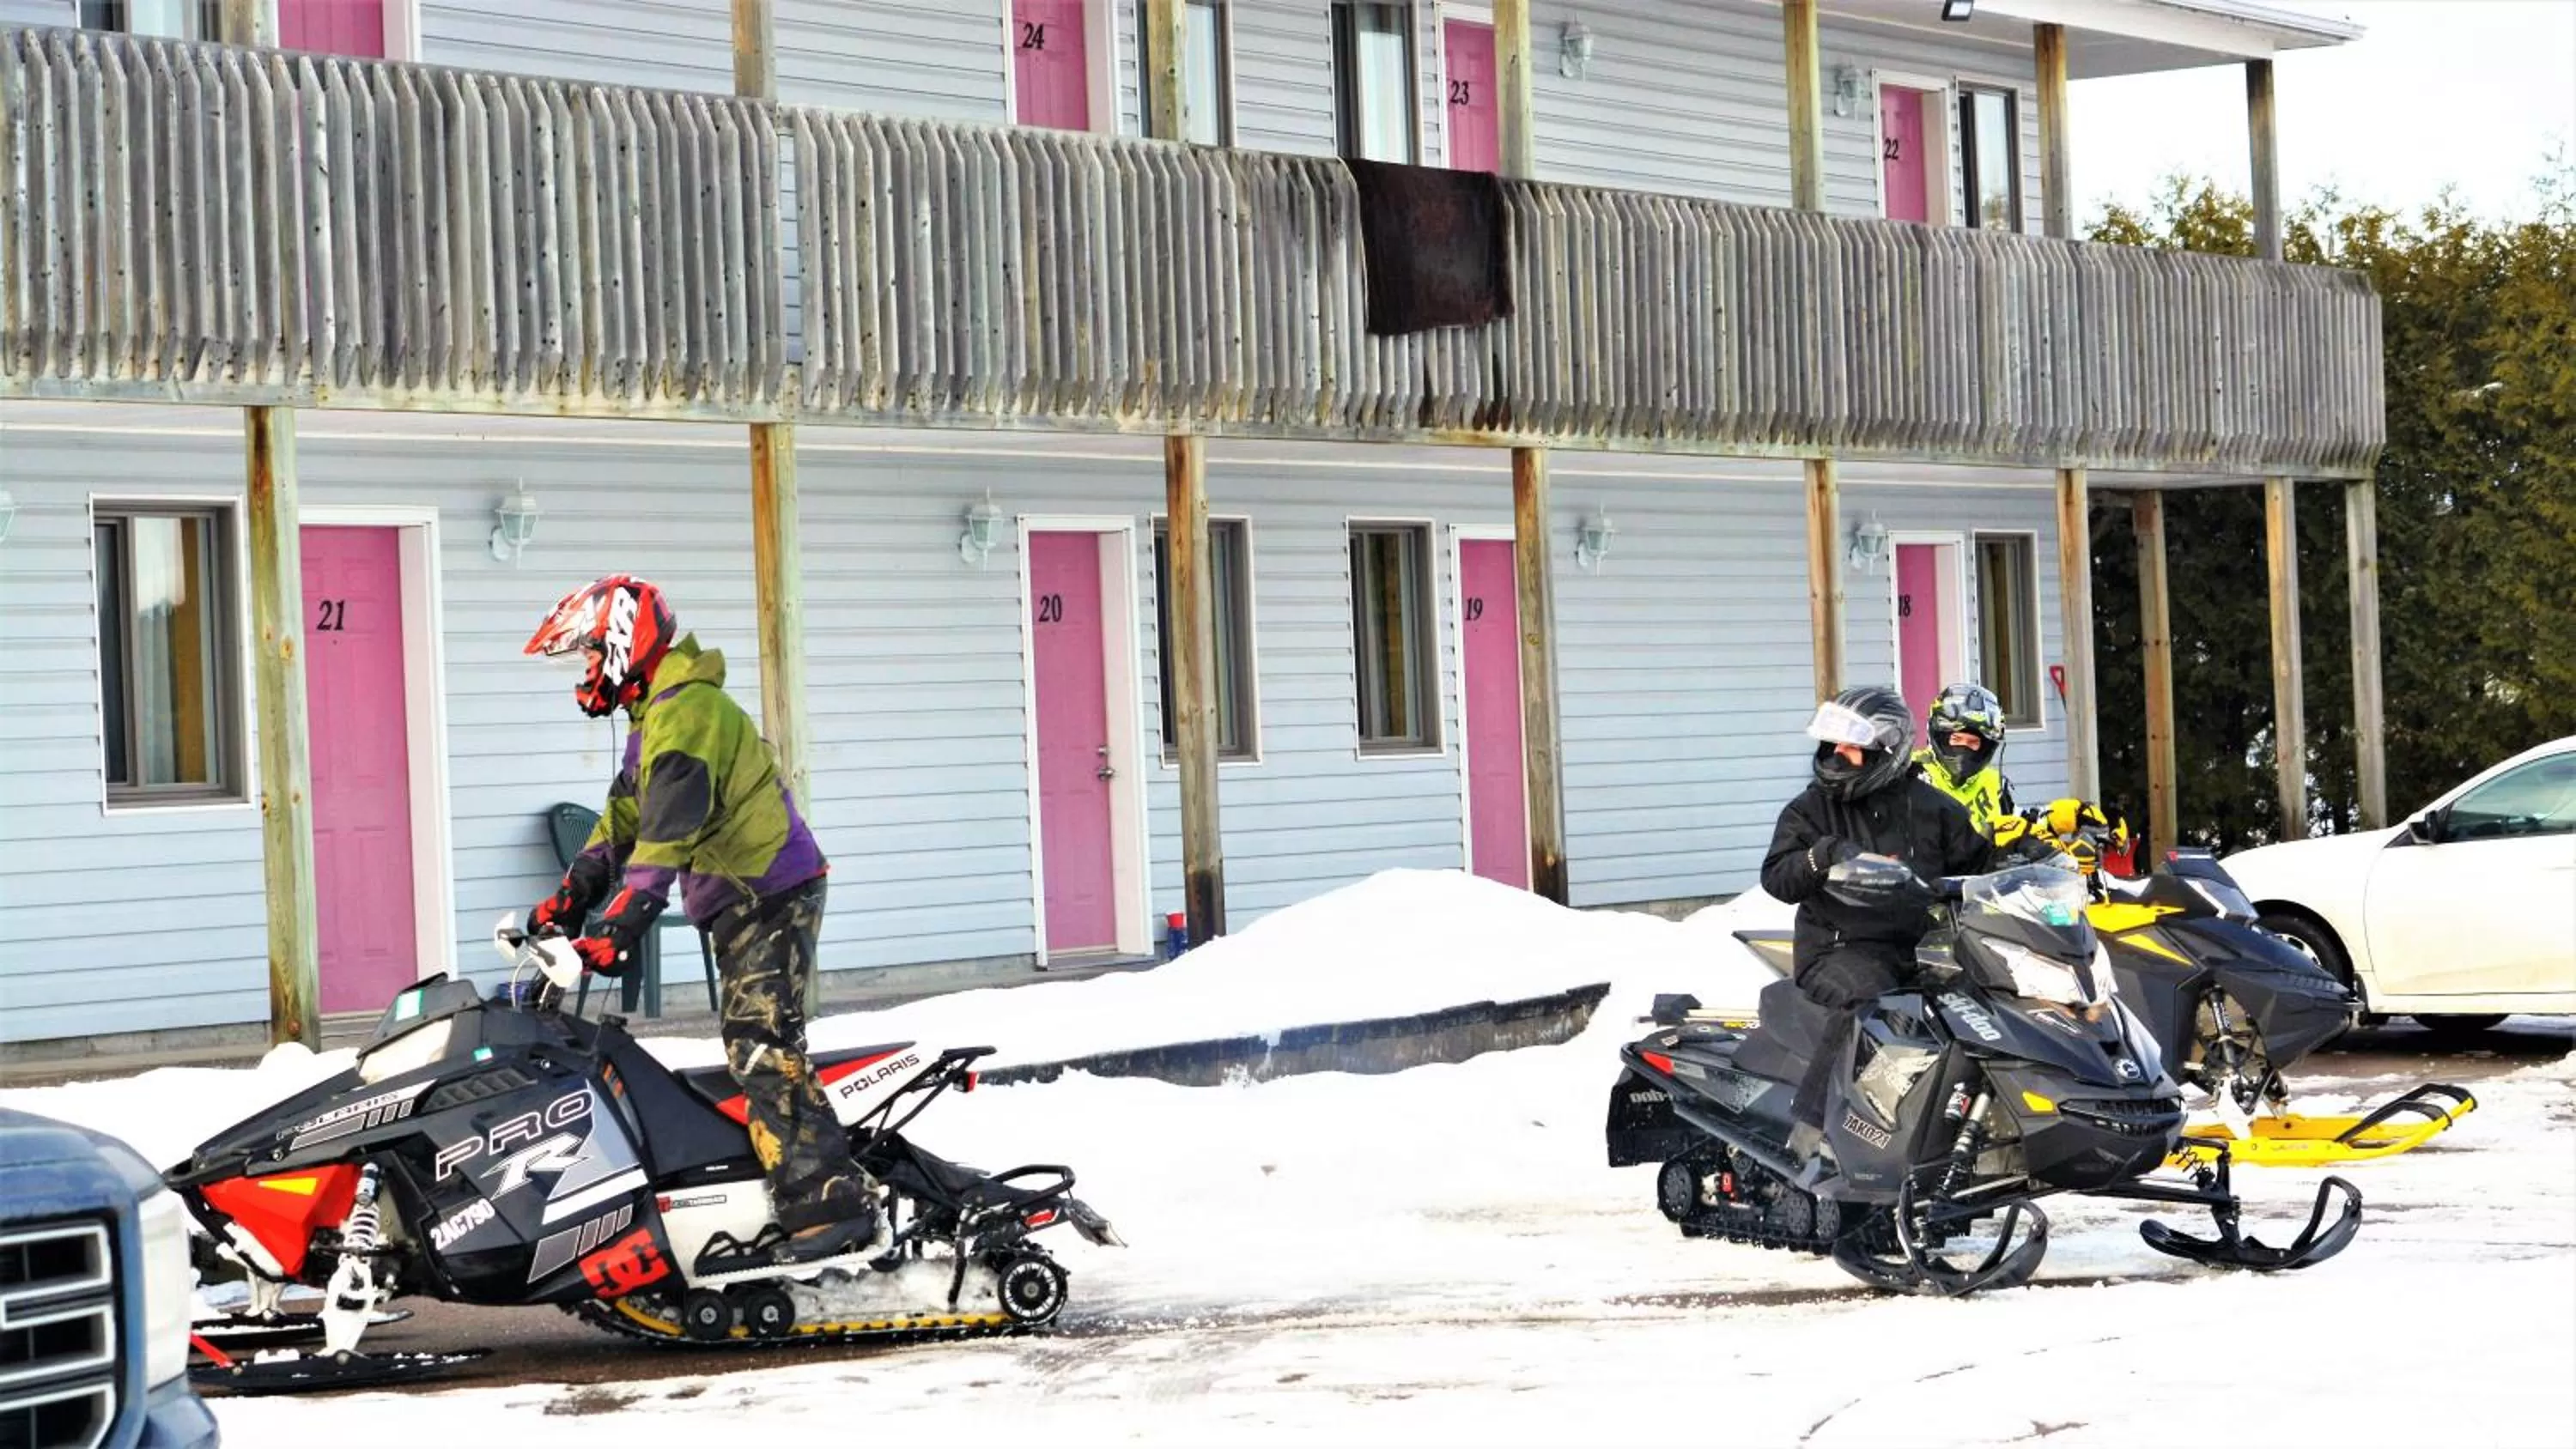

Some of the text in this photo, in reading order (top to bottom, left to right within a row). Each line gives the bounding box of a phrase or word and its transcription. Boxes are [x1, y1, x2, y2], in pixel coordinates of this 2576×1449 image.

[1022, 21, 1045, 50] 24
[1449, 79, 1469, 105] 23
[1884, 137, 1899, 161] 22
[316, 599, 345, 631] 21
[1037, 593, 1062, 622] 20
[1464, 597, 1484, 621] 19
[1898, 593, 1911, 617] 18
[839, 1052, 920, 1100] POLARIS
[435, 1088, 596, 1183] PRO
[480, 1131, 594, 1202] R
[430, 1197, 494, 1251] 2AC790
